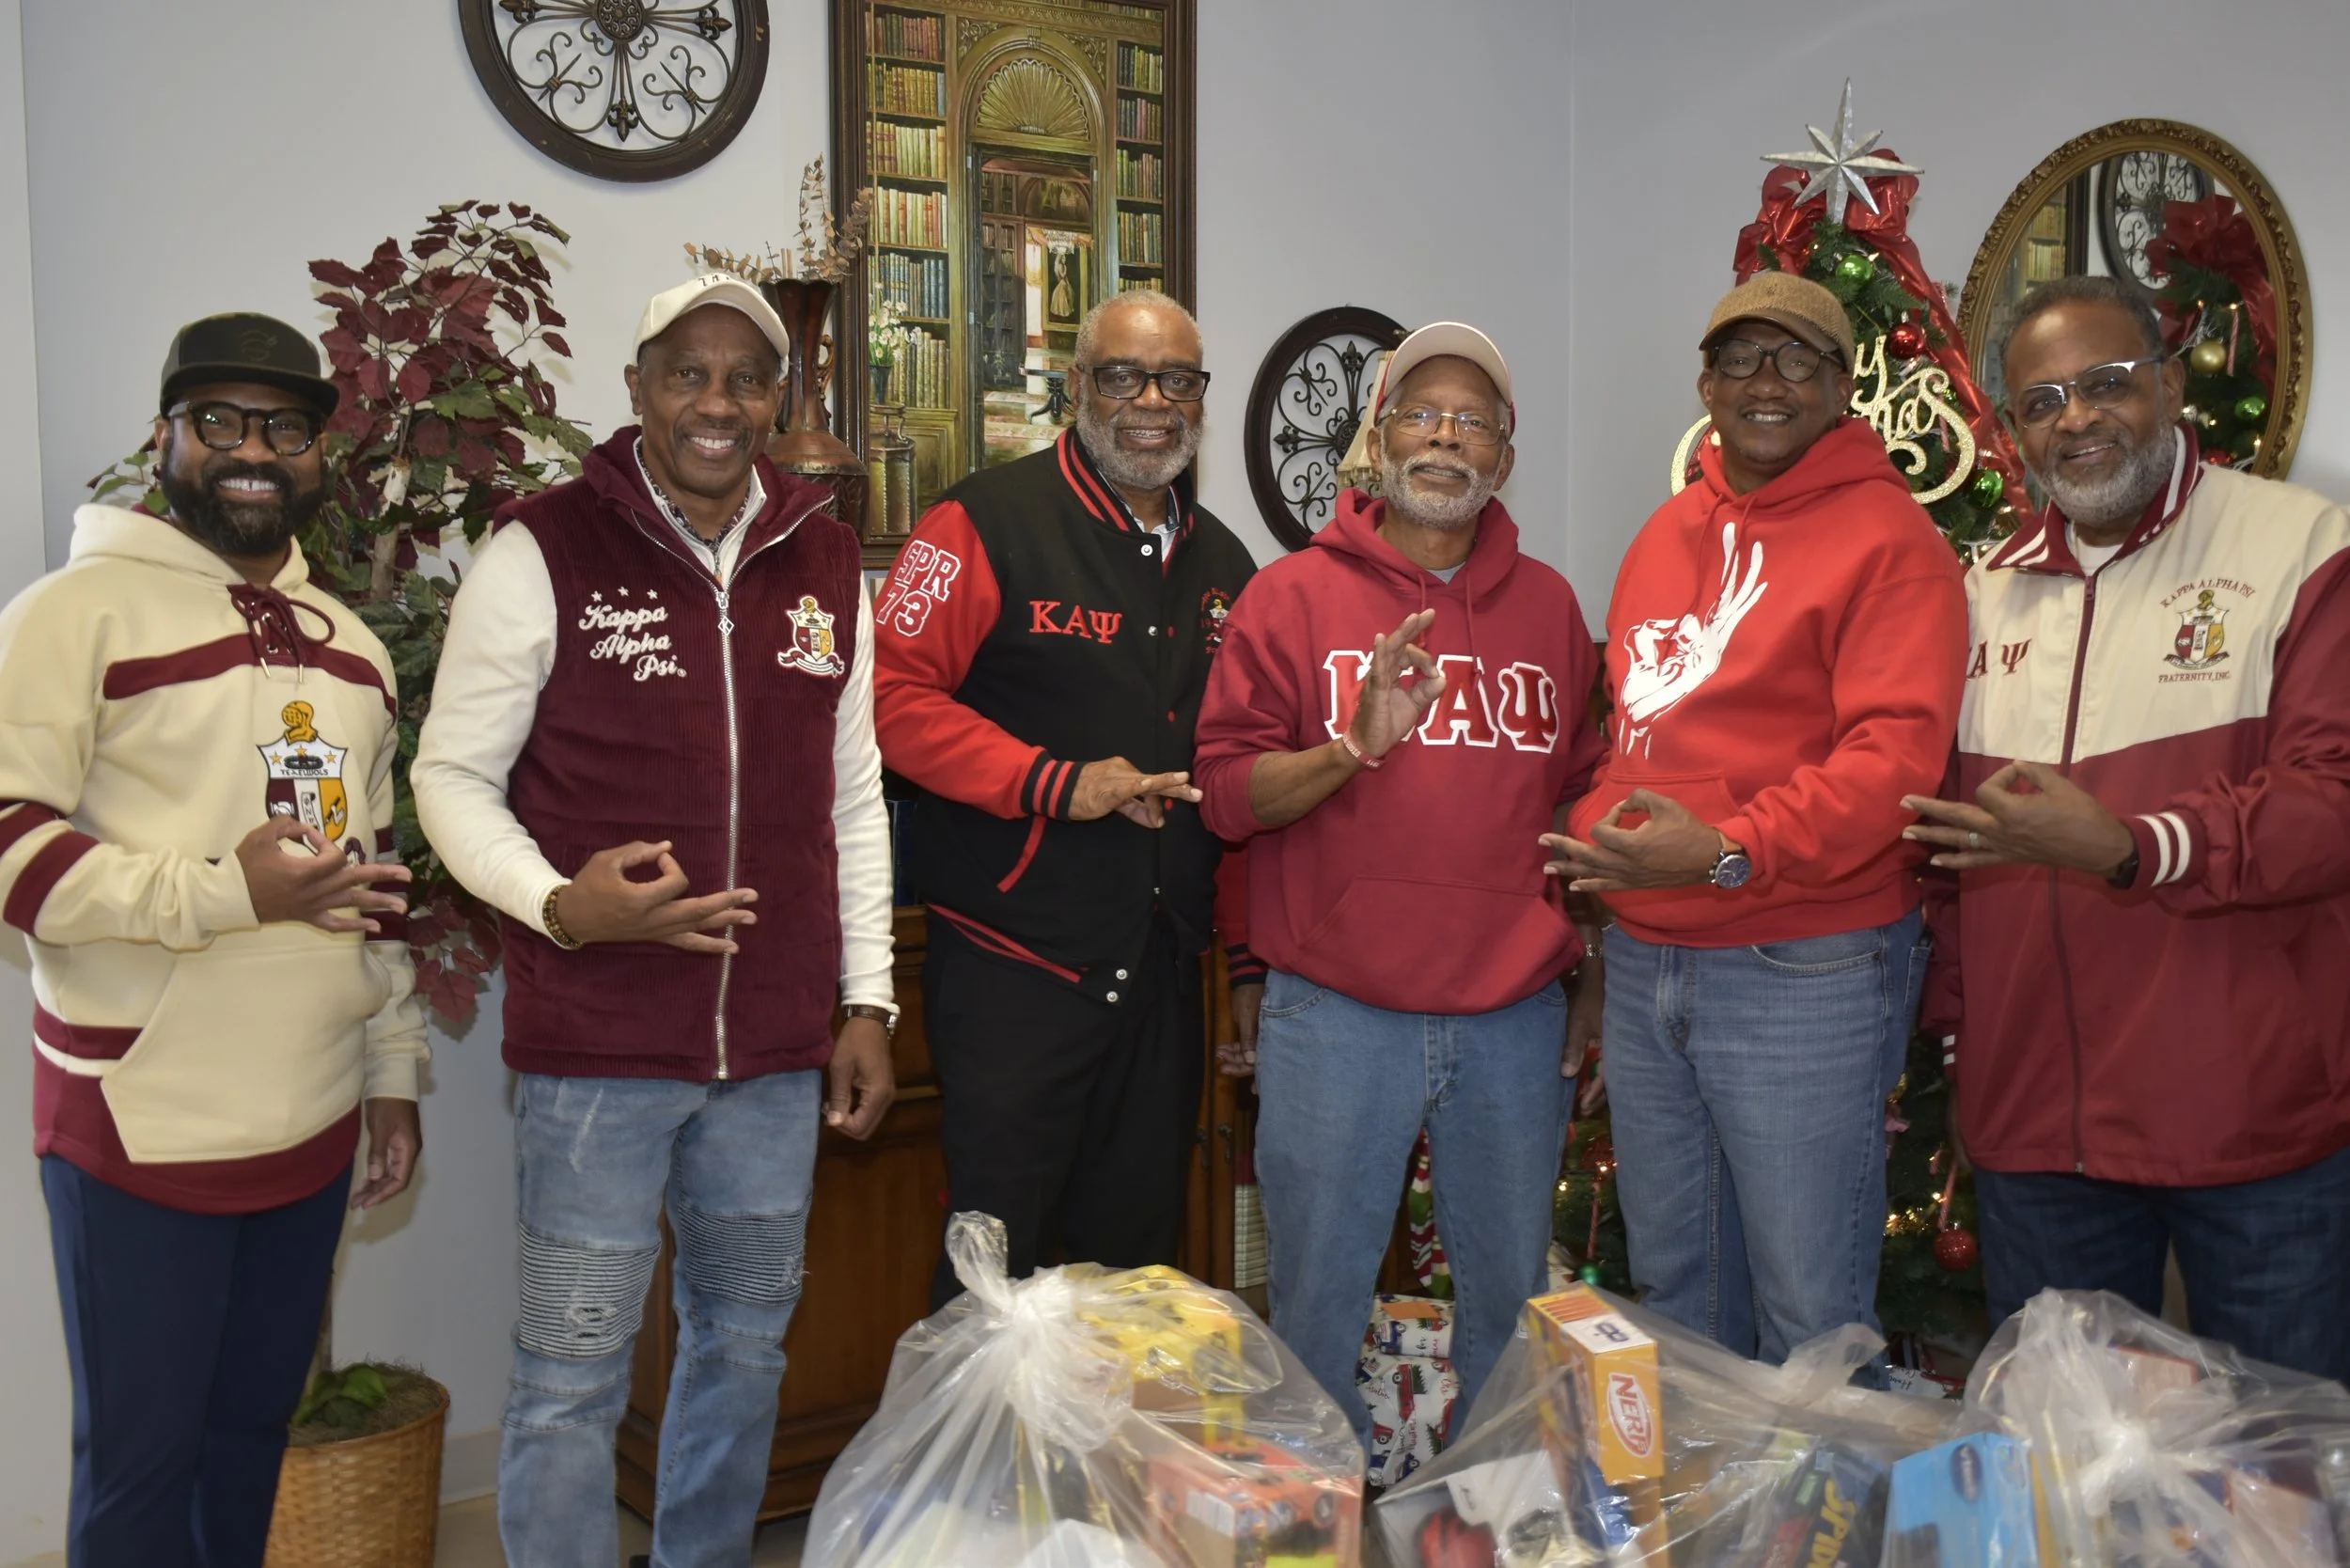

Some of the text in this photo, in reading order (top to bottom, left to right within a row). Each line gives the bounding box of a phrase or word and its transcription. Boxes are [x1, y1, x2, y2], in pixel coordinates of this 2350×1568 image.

[894, 539, 962, 603] SPR
[2199, 578, 2239, 592] ALPHA
[578, 604, 669, 635] Kappa
[876, 581, 932, 637] 73
[589, 632, 672, 665] Alpha
[1608, 1373, 1652, 1450] NERF
[1805, 1478, 1857, 1568] SPID
